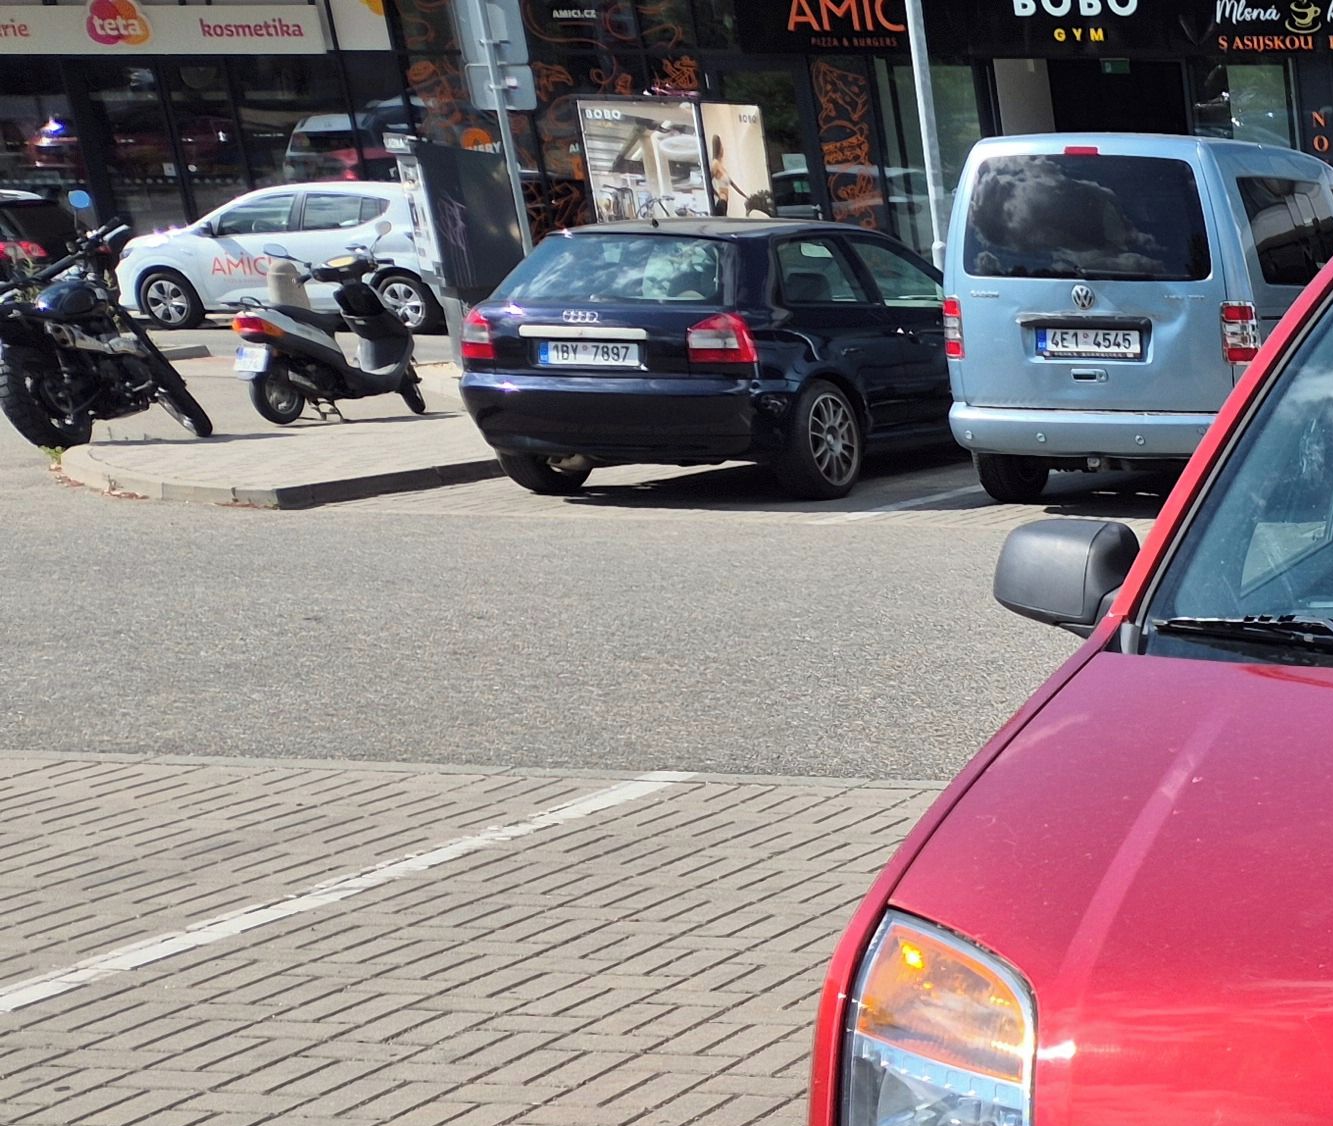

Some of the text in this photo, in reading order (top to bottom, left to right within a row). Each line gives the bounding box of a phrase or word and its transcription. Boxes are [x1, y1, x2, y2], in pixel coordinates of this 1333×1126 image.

[787, 0, 907, 32] AMIC
[0, 19, 30, 37] rie
[91, 16, 142, 36] teta
[199, 18, 304, 38] kosmetika
[1053, 27, 1105, 42] GYM
[1218, 35, 1228, 50] S
[1232, 35, 1314, 51] ASIJSKOU
[585, 109, 622, 120] BOBO
[1051, 331, 1132, 349] 4E1 4545
[552, 343, 630, 362] 1BY 7897
